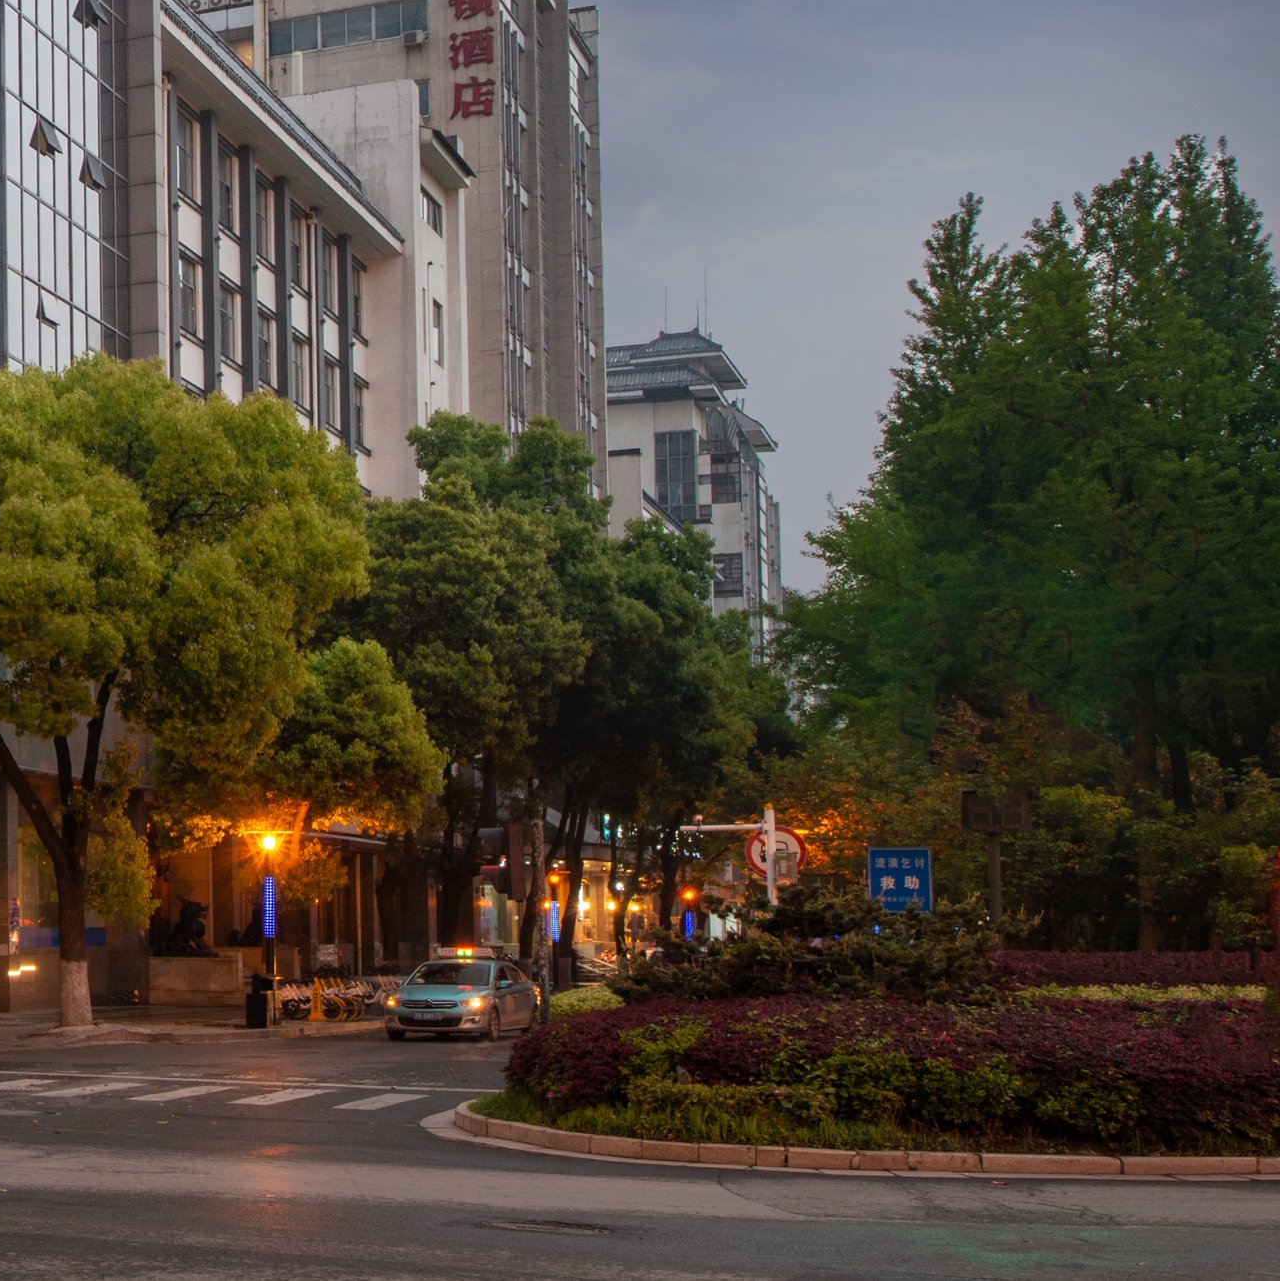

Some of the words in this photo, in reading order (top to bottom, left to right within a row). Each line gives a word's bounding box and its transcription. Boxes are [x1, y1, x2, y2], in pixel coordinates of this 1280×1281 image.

[874, 857, 925, 869] 流浪乞讨
[880, 875, 920, 890] 救助
